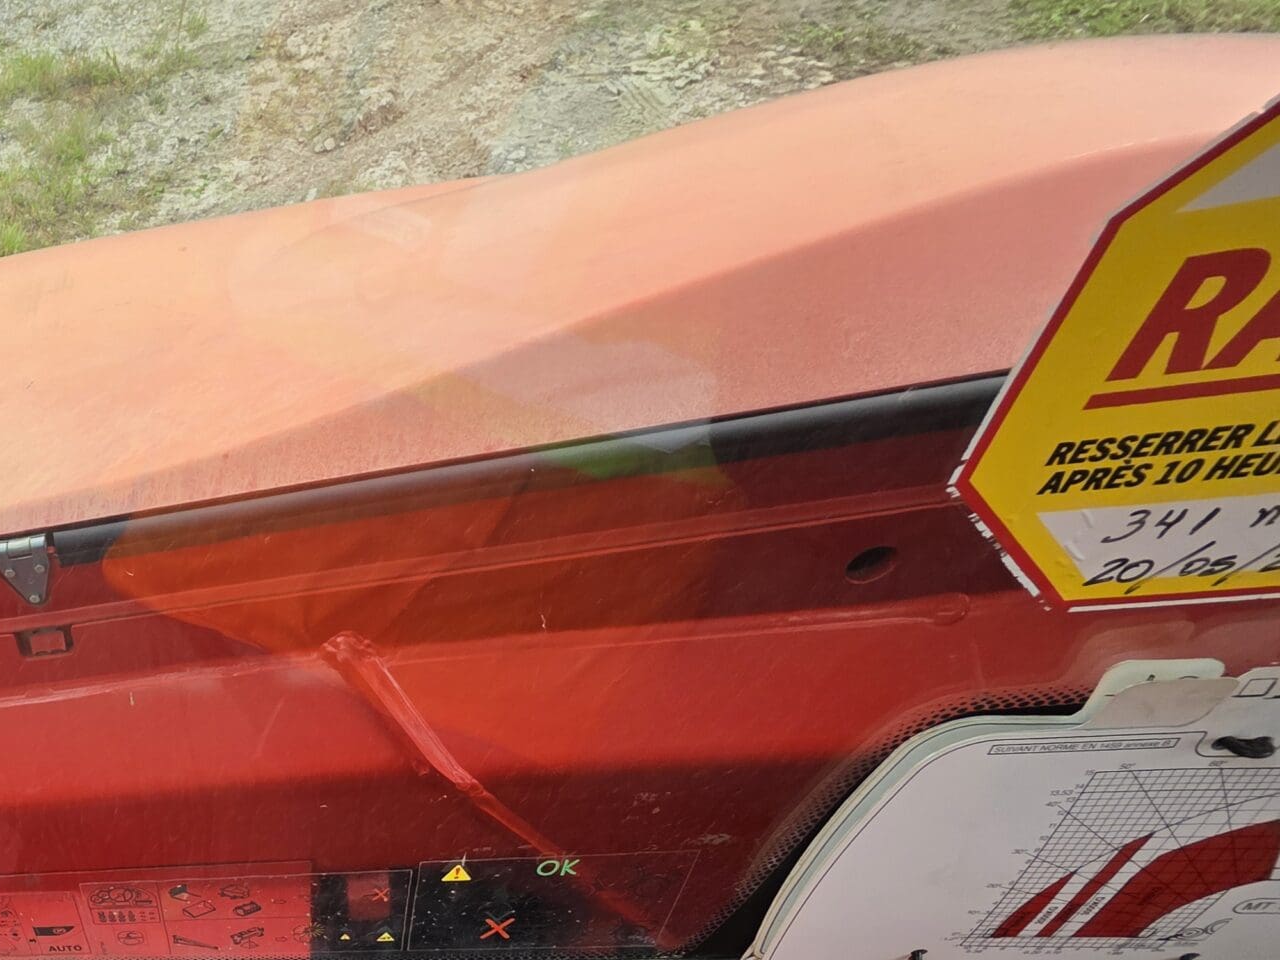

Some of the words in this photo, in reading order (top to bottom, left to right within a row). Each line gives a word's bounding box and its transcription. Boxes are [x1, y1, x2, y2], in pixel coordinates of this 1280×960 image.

[1044, 423, 1256, 466] RESSERRER
[1036, 458, 1153, 495] APRÈS
[1152, 458, 1206, 486] 10
[1202, 451, 1280, 481] HEU
[1101, 508, 1221, 544] 341
[994, 744, 1037, 754] SUIVANT
[1039, 742, 1079, 752] NORME
[1081, 742, 1098, 751] EN
[1122, 740, 1160, 750] annexe
[536, 858, 581, 877] OK
[49, 944, 83, 952] AUTO
